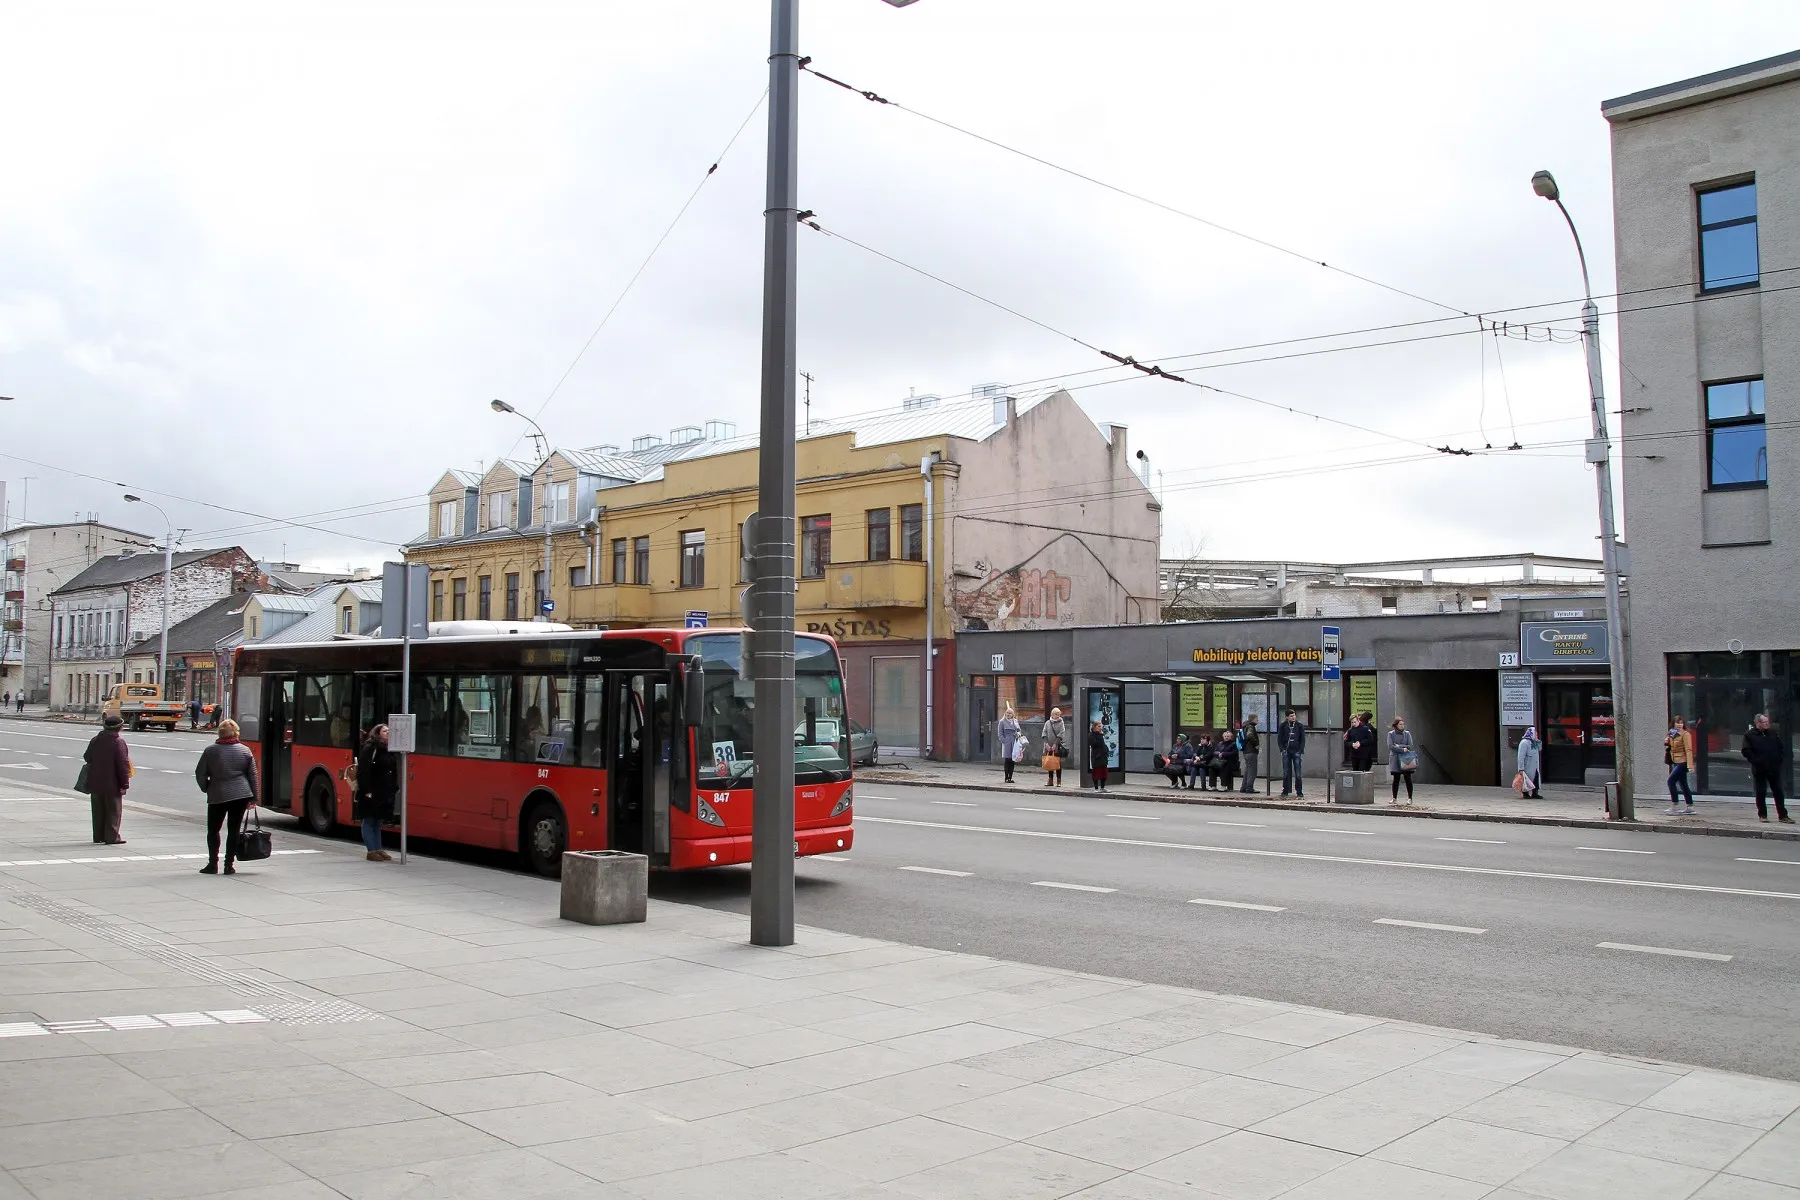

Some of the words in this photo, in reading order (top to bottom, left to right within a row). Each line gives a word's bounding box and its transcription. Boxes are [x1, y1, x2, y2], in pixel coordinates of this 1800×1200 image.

[806, 618, 891, 639] PAŠTAS
[1540, 629, 1588, 642] CENTRINĖ
[1555, 641, 1582, 649] RAKTŲ
[1193, 648, 1245, 664] Mobiliųjų
[1247, 647, 1294, 664] telefonų
[714, 745, 735, 762] 38
[537, 768, 549, 779] 847
[713, 792, 730, 803] 847
